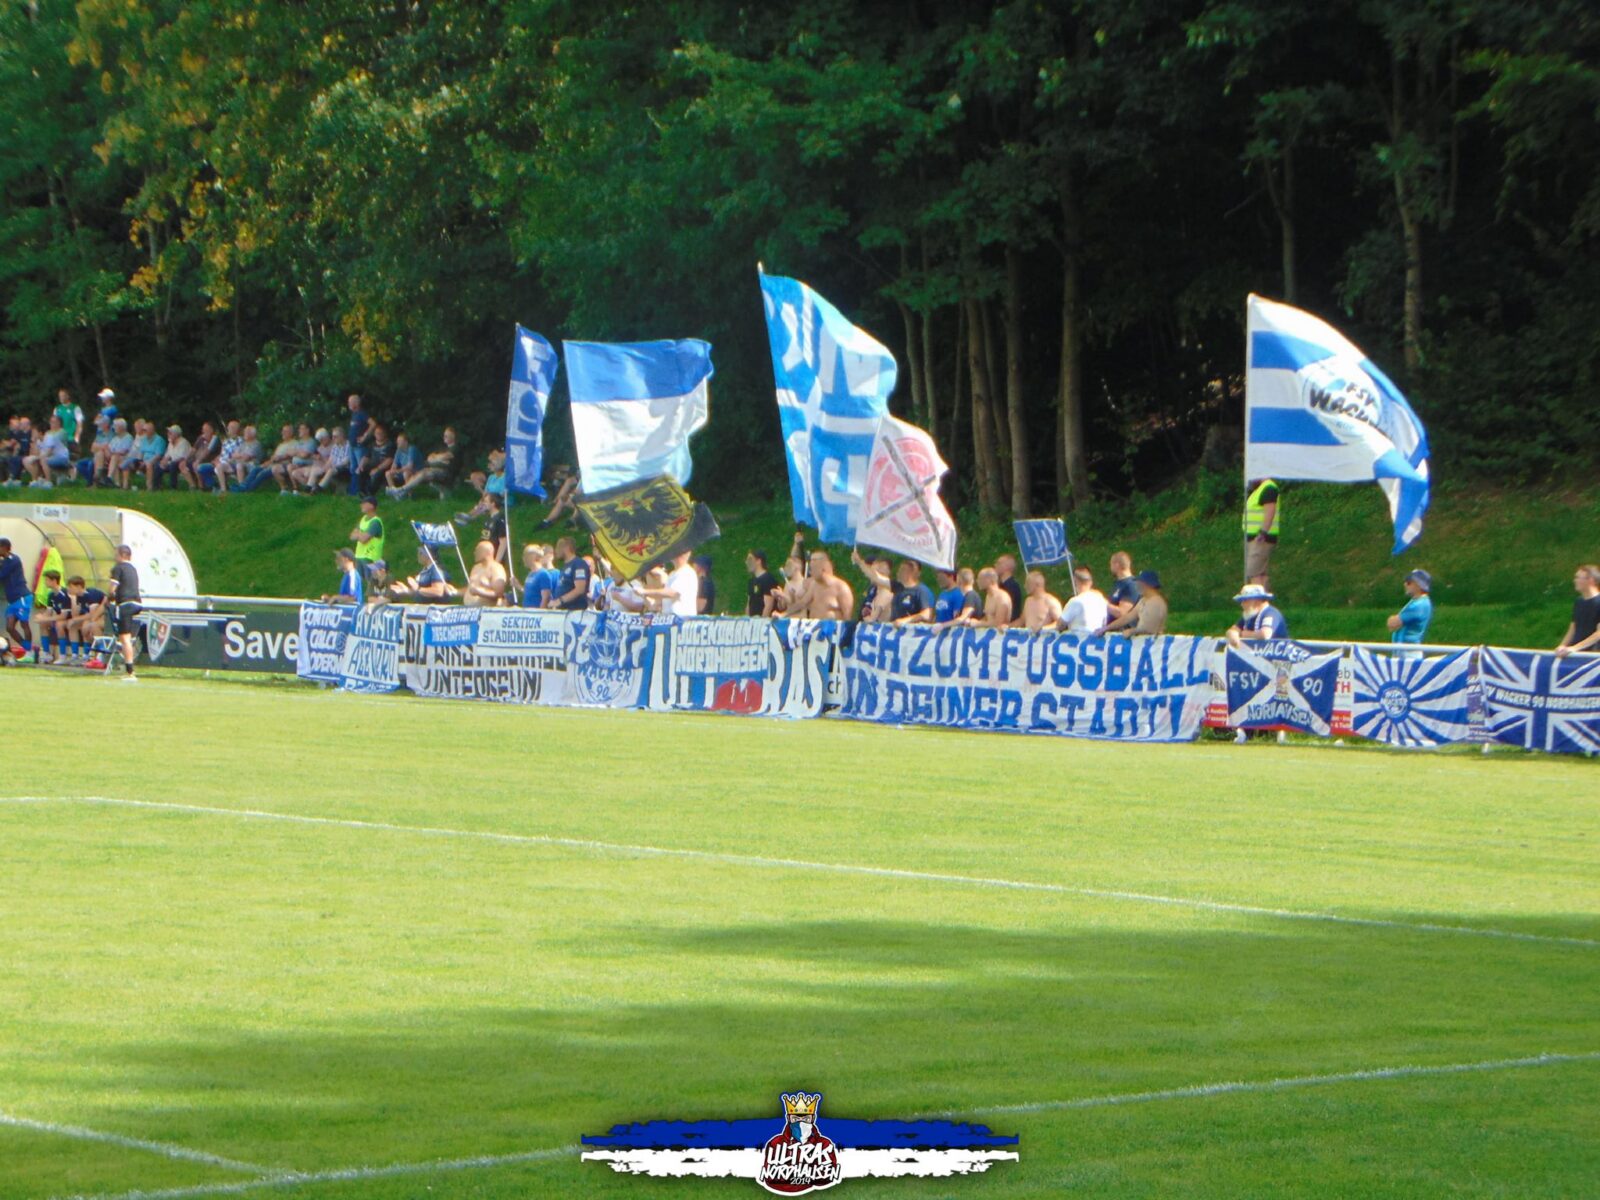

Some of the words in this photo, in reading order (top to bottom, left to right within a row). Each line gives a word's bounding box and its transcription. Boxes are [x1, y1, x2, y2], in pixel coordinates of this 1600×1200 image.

[502, 616, 542, 629] SEKTION
[677, 619, 769, 646] JUGENDBANDE
[224, 620, 299, 660] Save
[482, 630, 560, 645] STADIONVERBOT
[676, 645, 768, 673] NORDHAUSEN
[908, 625, 998, 679] ZUM
[998, 629, 1209, 692] FUSSBALL
[1251, 641, 1310, 662] WACKER
[578, 663, 633, 686] WACKER
[1228, 671, 1260, 689] FSV
[1302, 677, 1324, 696] 90
[840, 667, 878, 716] IN
[880, 679, 1023, 728] DEINER
[1029, 692, 1187, 738] STADT!
